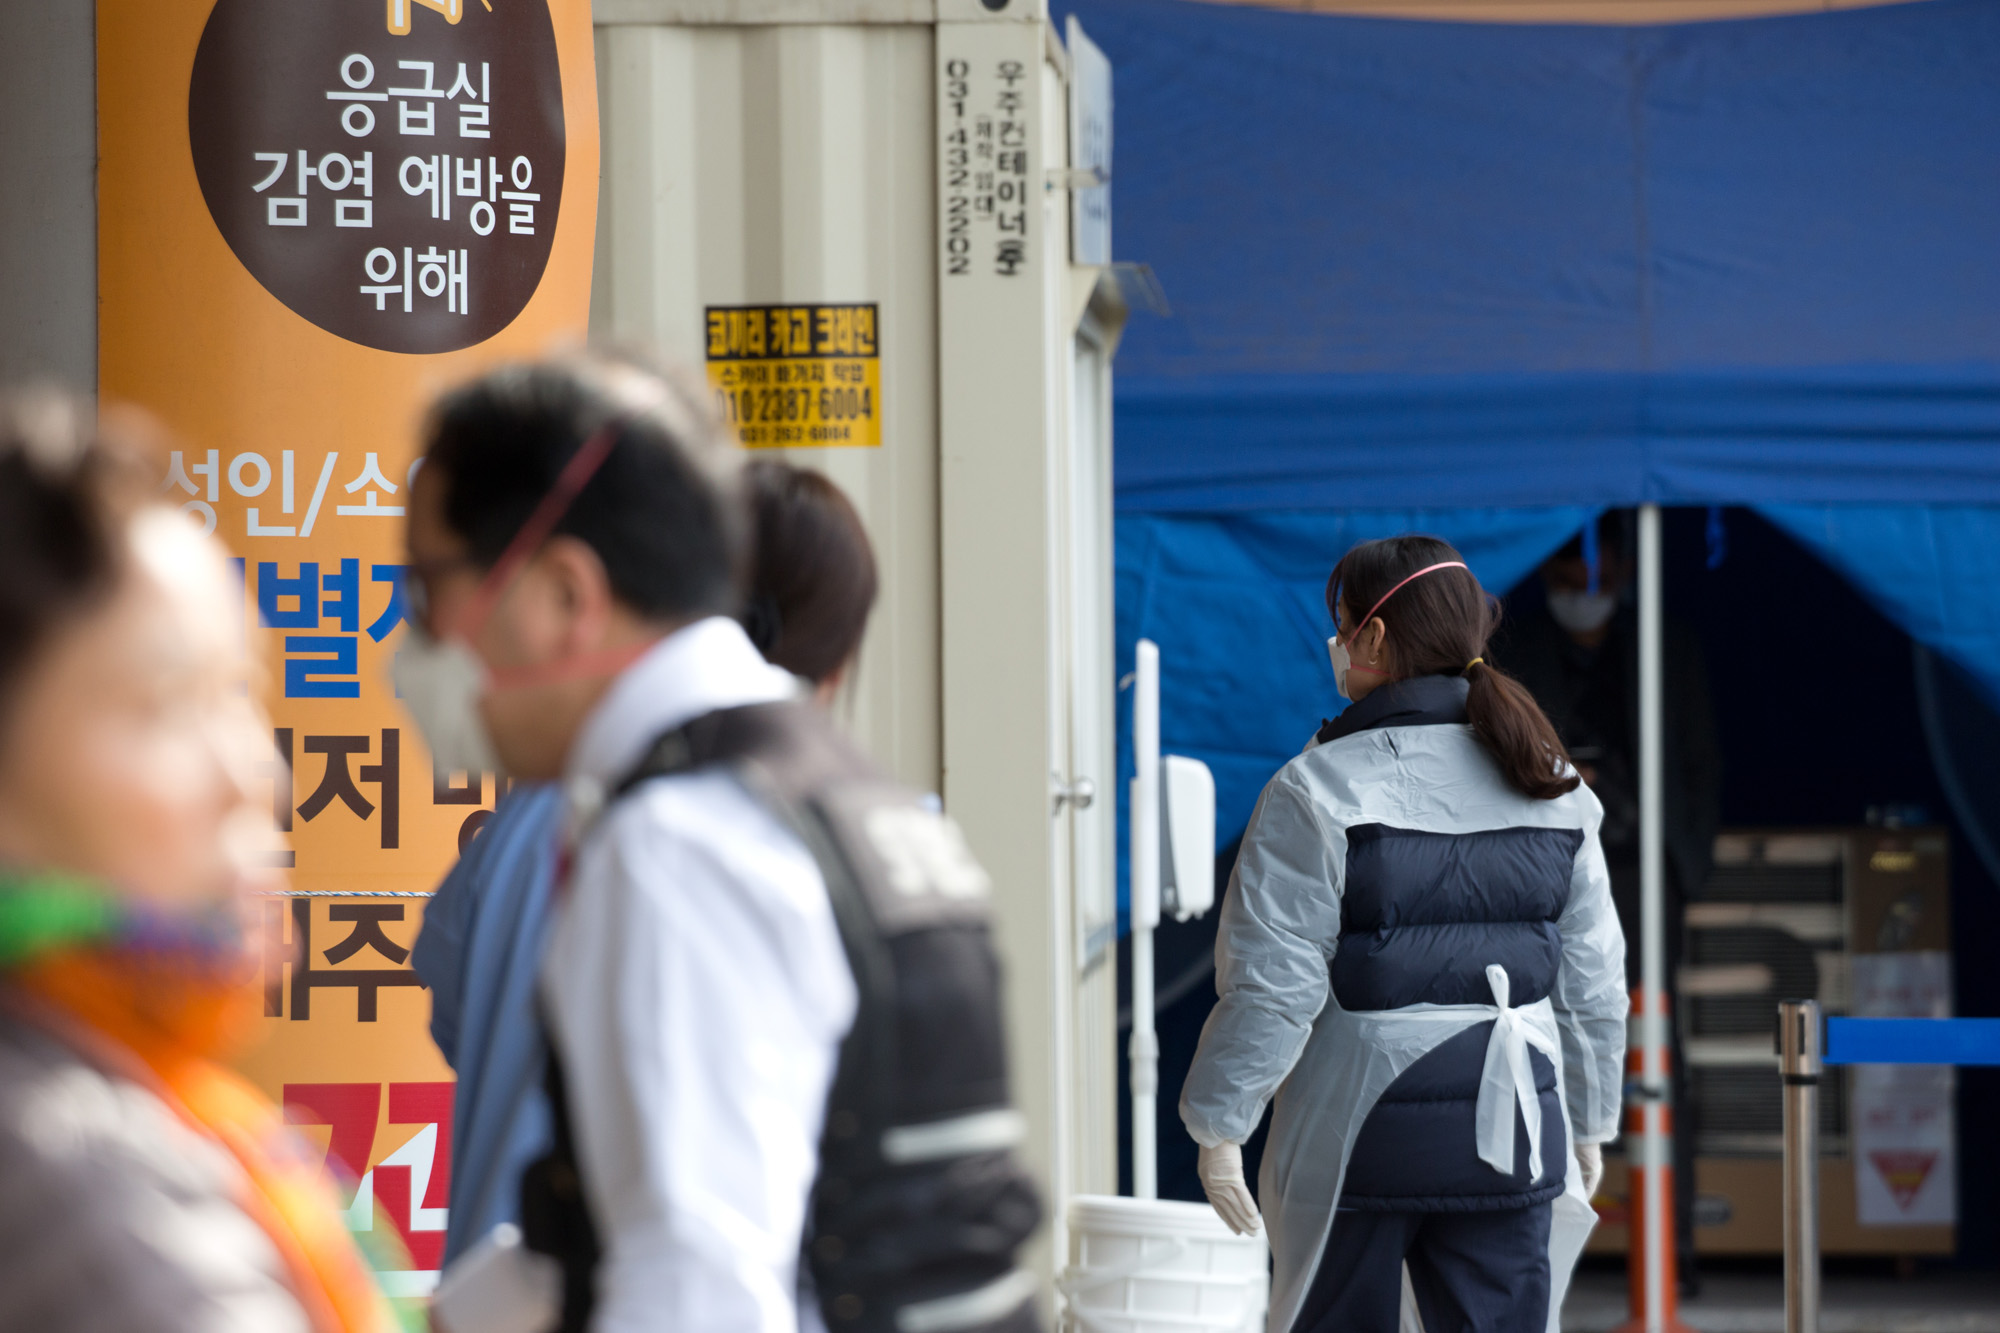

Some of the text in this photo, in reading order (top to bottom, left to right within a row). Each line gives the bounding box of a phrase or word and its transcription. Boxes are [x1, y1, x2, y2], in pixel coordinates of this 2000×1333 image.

[326, 53, 491, 138] 응급실
[252, 150, 541, 237] 감염 예방을
[360, 246, 469, 315] 위해
[817, 307, 875, 354] 크레인
[160, 449, 428, 538] 성인/소
